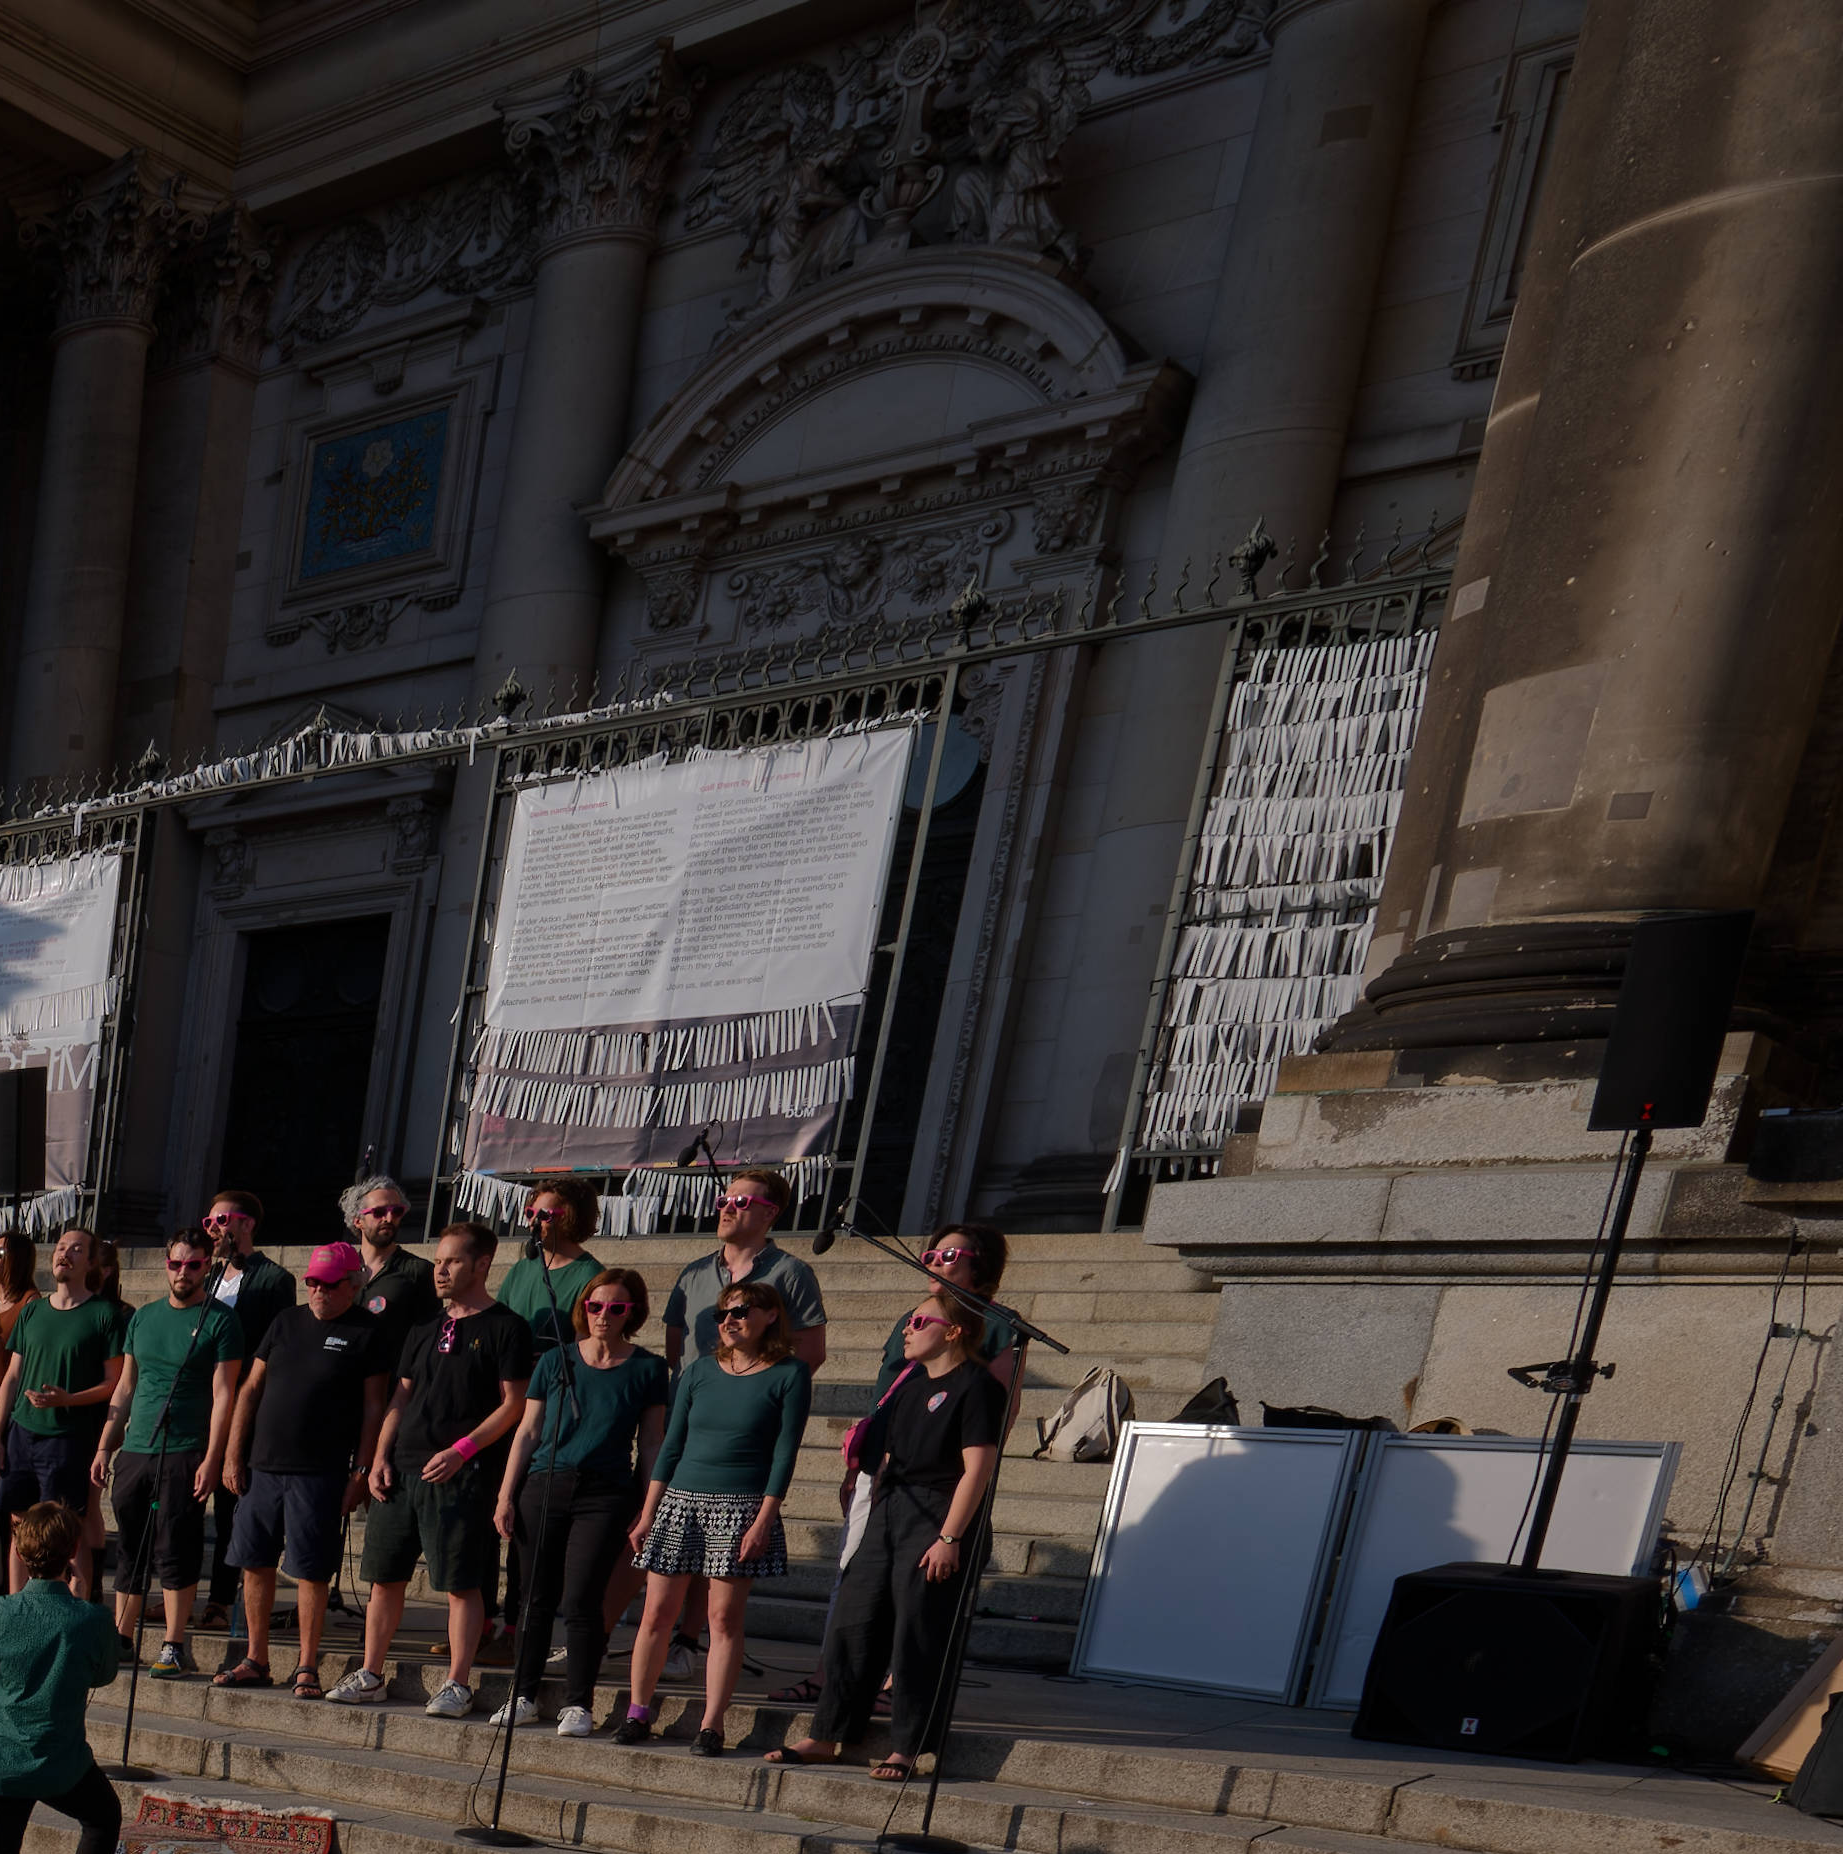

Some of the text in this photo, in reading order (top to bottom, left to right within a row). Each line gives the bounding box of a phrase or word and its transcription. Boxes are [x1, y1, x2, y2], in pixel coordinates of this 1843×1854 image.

[697, 801, 716, 811] Over
[717, 799, 734, 808] 122
[734, 795, 762, 806] million
[763, 792, 792, 804] people
[809, 784, 848, 798] currently
[770, 800, 791, 812] They
[792, 797, 814, 807] have
[815, 796, 826, 804] to
[826, 792, 851, 802] leave
[852, 789, 873, 799] their
[721, 814, 757, 825] because
[758, 811, 780, 821] there
[811, 805, 831, 816] they
[848, 800, 874, 812] being
[691, 826, 736, 841] persecuted
[748, 820, 785, 832] because
[786, 818, 806, 829] they
[823, 812, 847, 824] living
[799, 825, 825, 837] Every
[720, 844, 743, 854] them
[744, 843, 758, 851] die
[772, 840, 787, 848] the
[805, 835, 828, 844] while
[829, 831, 862, 844] Europe
[737, 851, 767, 863] tighten
[768, 849, 783, 858] the
[784, 846, 816, 858] asylum
[817, 842, 849, 854] system
[850, 840, 868, 849] and
[684, 866, 712, 876] human
[713, 864, 737, 875] rights
[754, 858, 788, 869] violated
[810, 854, 831, 865] daily
[700, 885, 715, 894] the
[737, 881, 759, 890] them
[760, 880, 772, 890] by
[773, 878, 792, 886] their
[706, 893, 728, 904] large
[728, 892, 744, 902] city
[745, 887, 784, 898] churches
[801, 882, 836, 894] sending
[691, 913, 712, 922] want
[723, 908, 767, 919] remember
[767, 906, 782, 915] the
[783, 904, 813, 915] people
[814, 901, 834, 910] who
[714, 900, 752, 913] solidarity
[752, 898, 771, 907] with
[697, 923, 716, 932] died
[764, 916, 782, 925] and
[805, 913, 821, 921] not
[745, 927, 764, 936] That
[774, 924, 792, 935] why
[700, 930, 836, 950] and reading out their names and
[671, 941, 828, 964] remembering the under
[670, 962, 694, 971] which
[694, 960, 712, 971] they
[667, 982, 684, 990] Join
[699, 979, 712, 988] set
[785, 1107, 816, 1118] DOM
